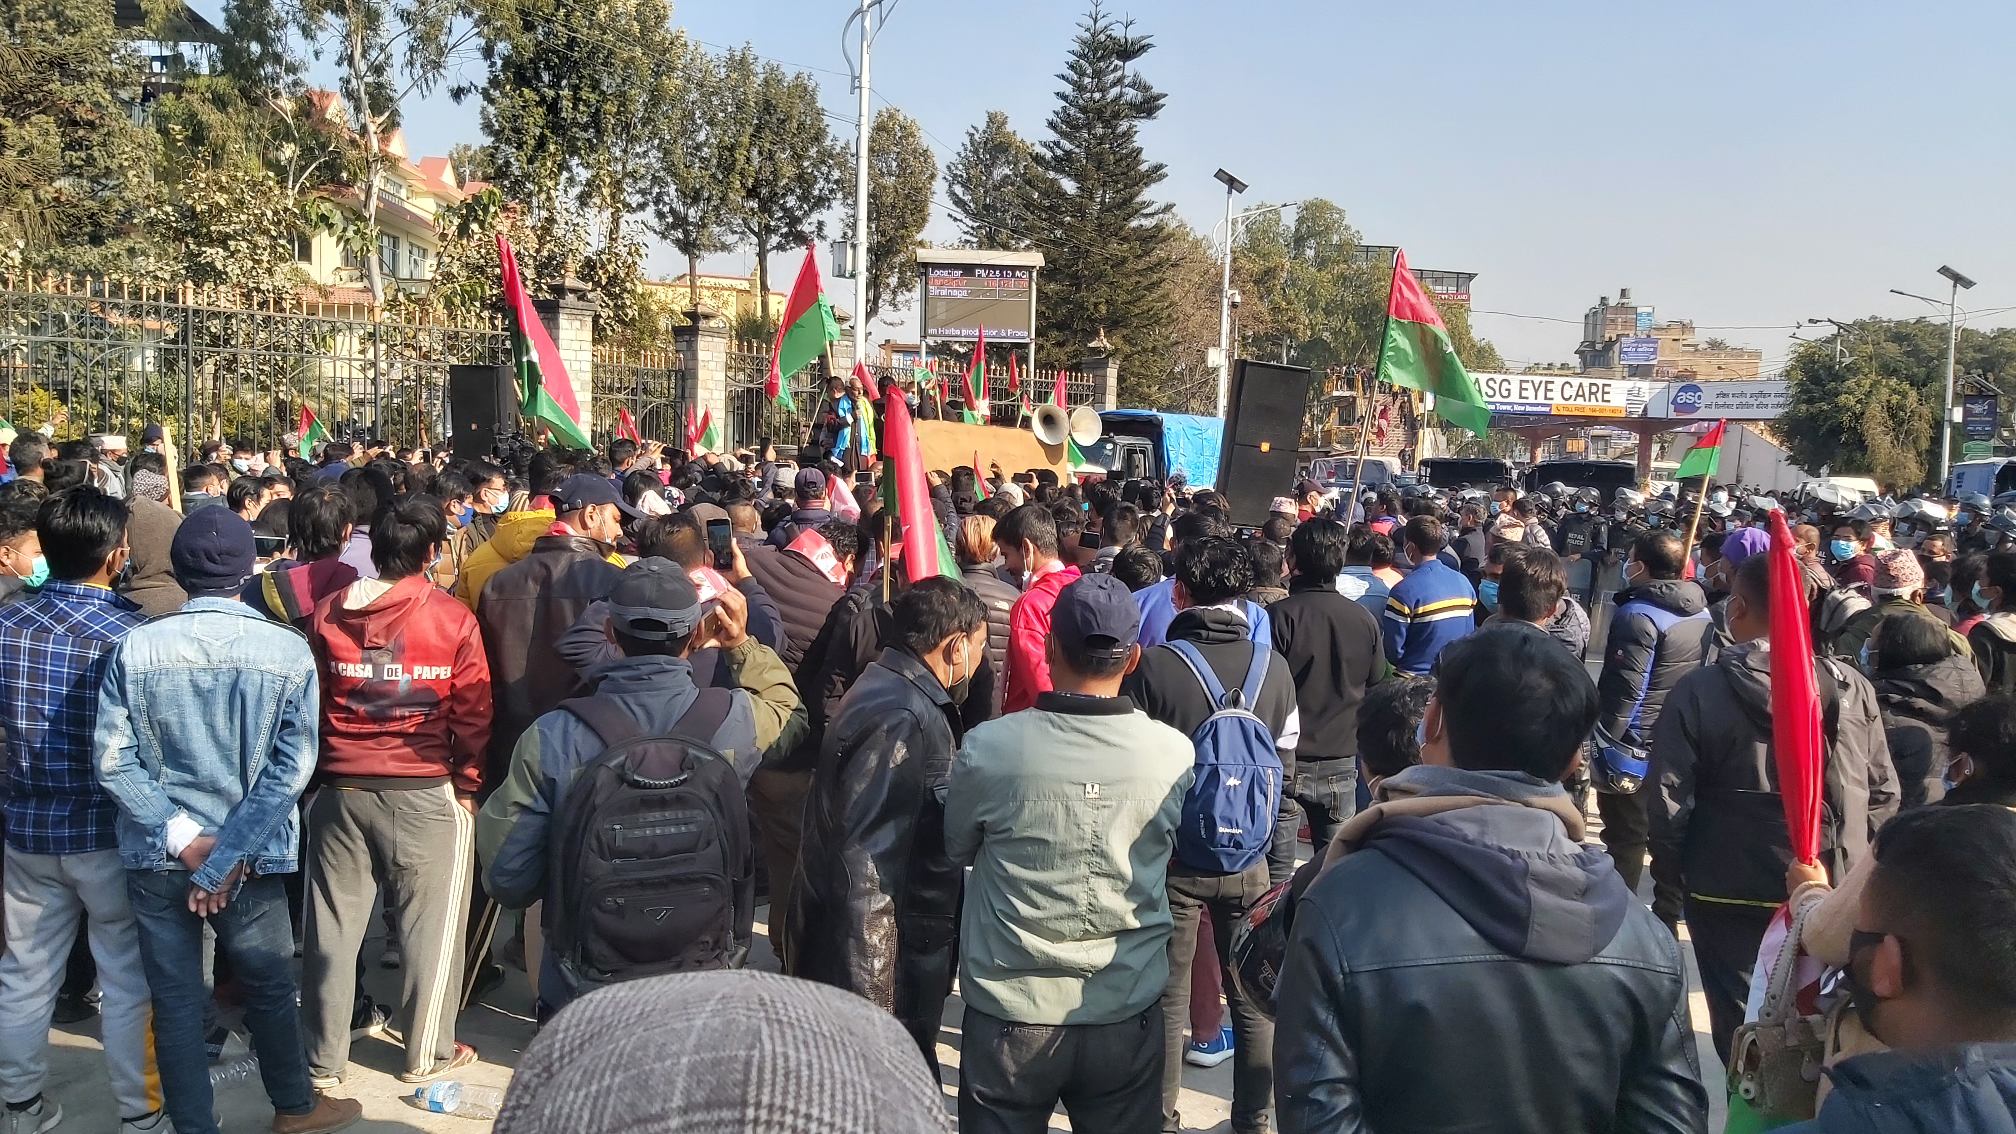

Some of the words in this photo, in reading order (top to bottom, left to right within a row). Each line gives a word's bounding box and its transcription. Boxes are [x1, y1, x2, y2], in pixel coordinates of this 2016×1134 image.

[1474, 377, 1511, 398] ASG
[1518, 380, 1555, 400] EYE
[1561, 381, 1612, 403] CARE
[1677, 391, 1703, 406] asg
[338, 663, 374, 678] CASA
[386, 667, 400, 678] DE
